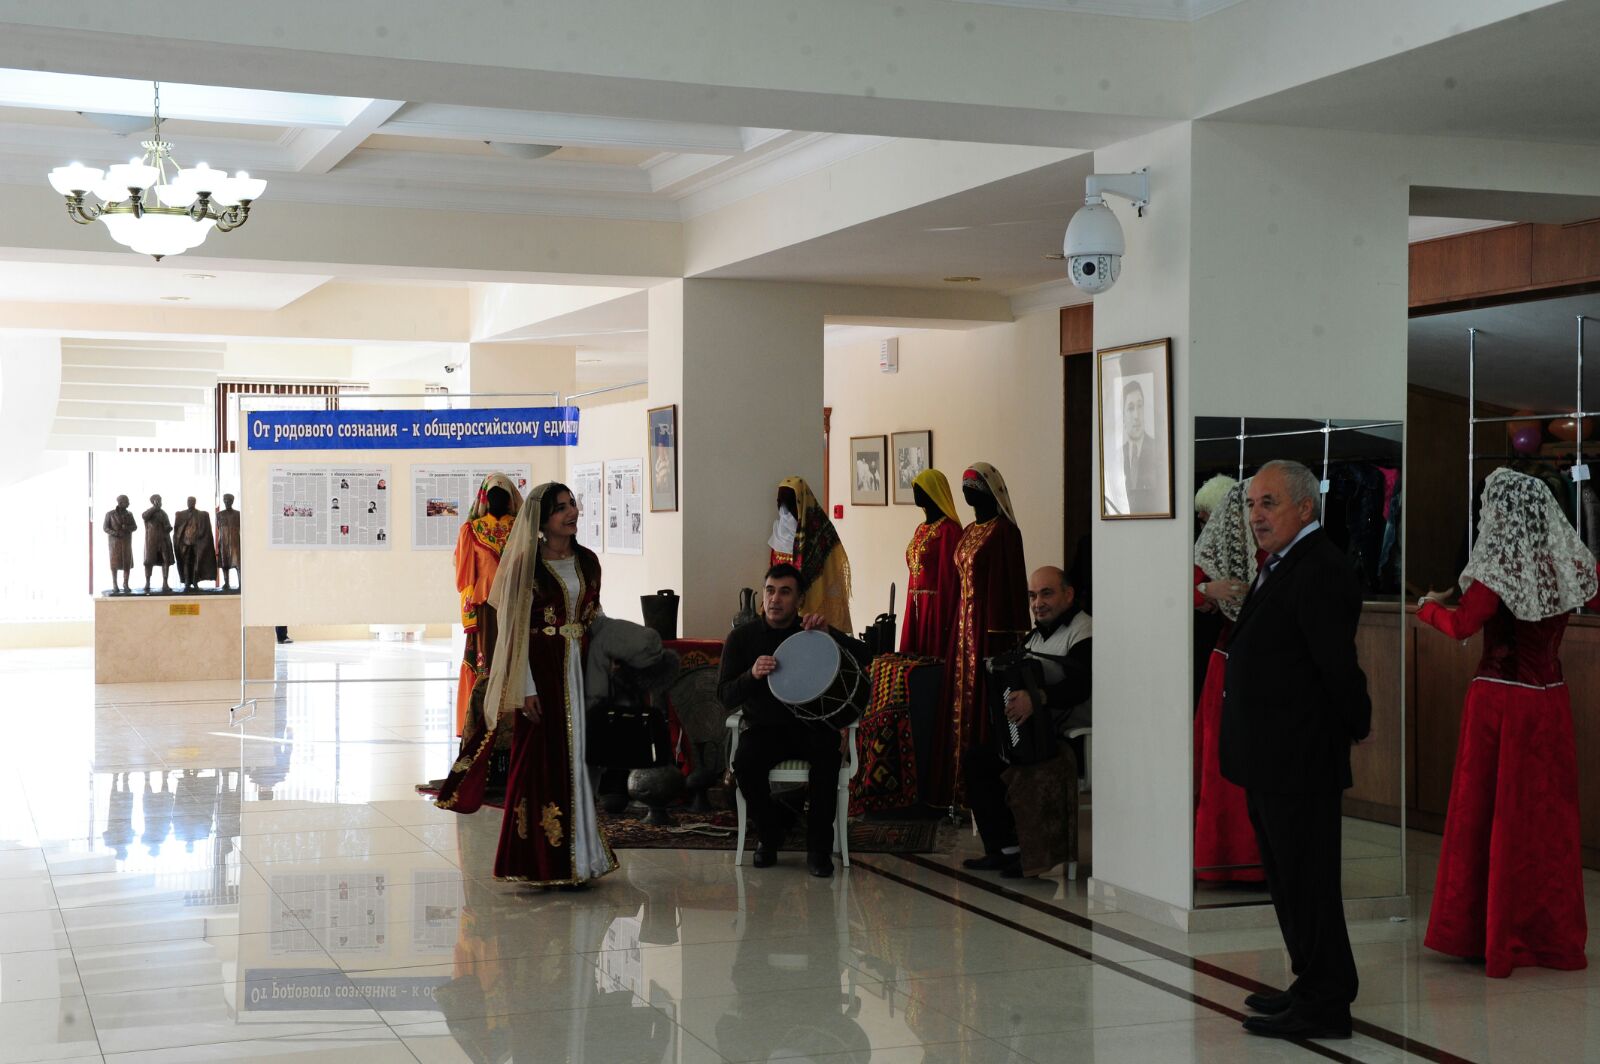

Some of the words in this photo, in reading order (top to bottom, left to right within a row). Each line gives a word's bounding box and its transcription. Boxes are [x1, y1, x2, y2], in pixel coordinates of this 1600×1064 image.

[253, 420, 270, 438] От
[274, 422, 333, 442] родового
[338, 423, 398, 437] сознания
[412, 424, 420, 436] к
[424, 417, 539, 440] общероссийскому
